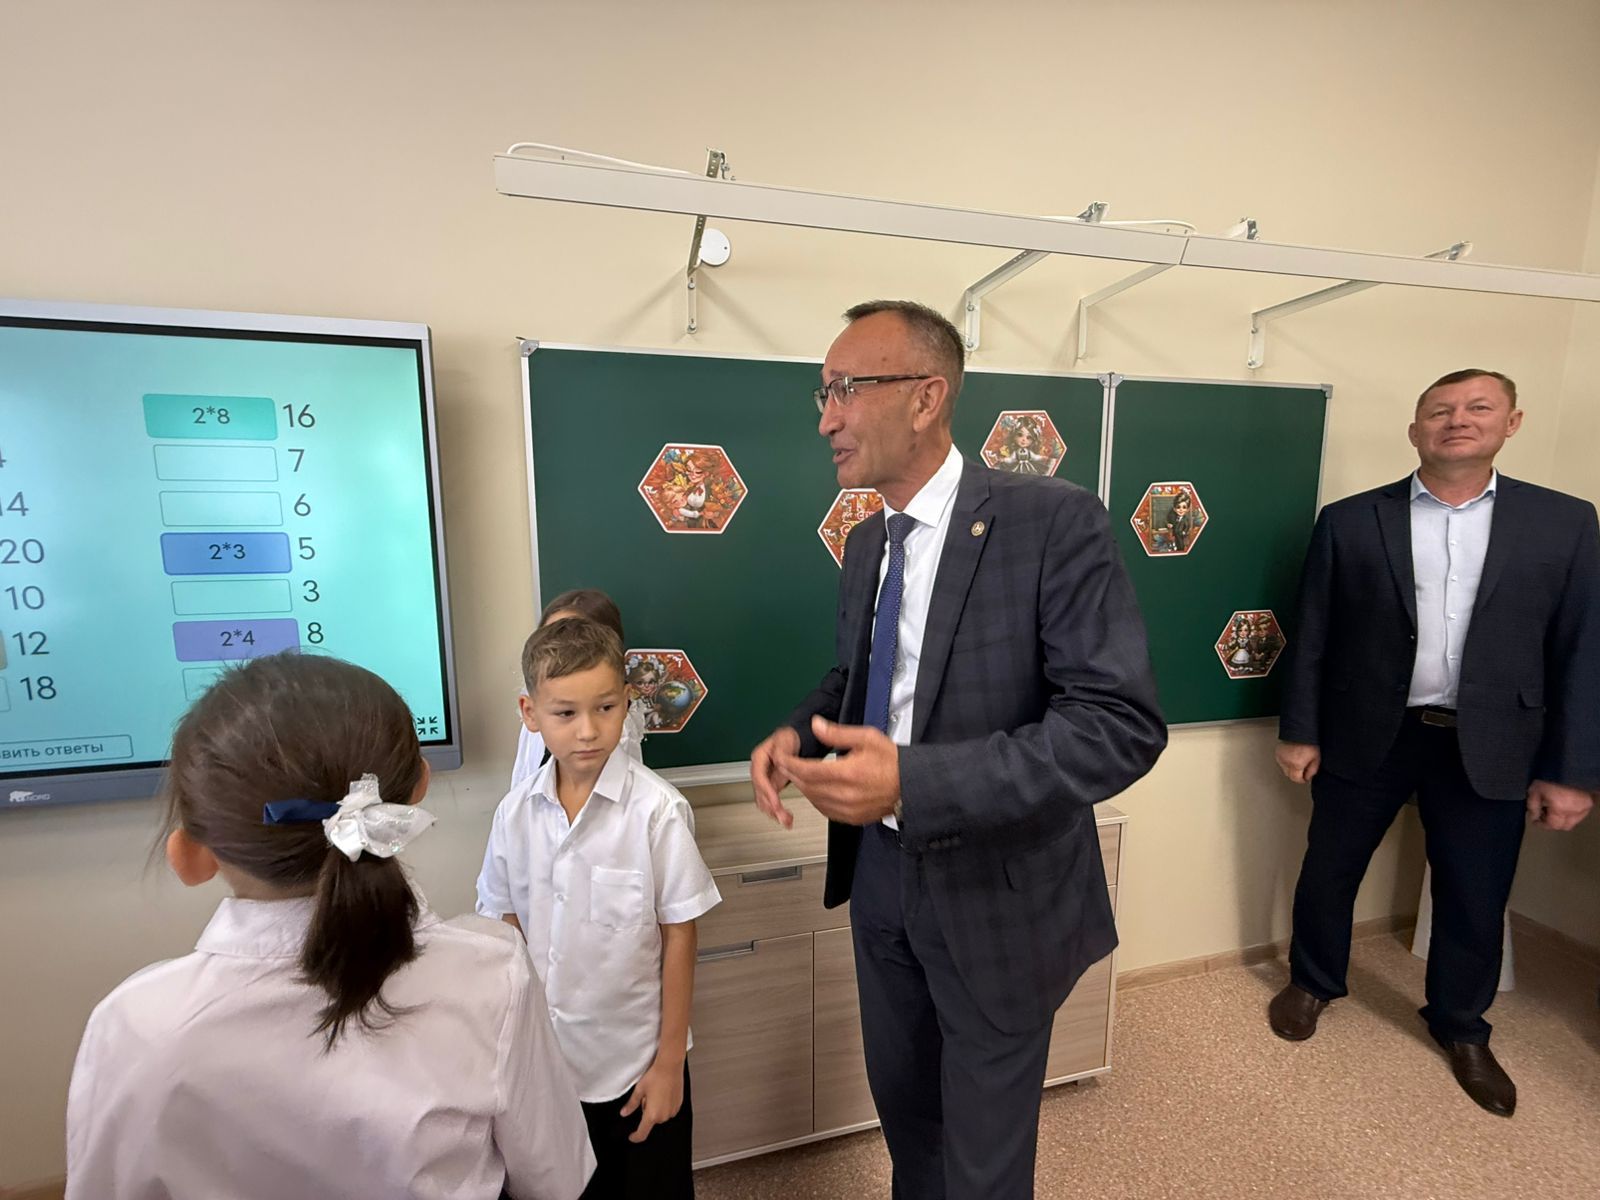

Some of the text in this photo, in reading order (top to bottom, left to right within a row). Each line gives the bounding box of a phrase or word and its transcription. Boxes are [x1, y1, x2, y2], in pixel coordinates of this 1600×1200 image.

[283, 403, 316, 428] 16
[288, 448, 305, 473] 7
[294, 493, 311, 517] 6
[0, 538, 45, 564] 20
[298, 537, 315, 560] 5
[5, 585, 45, 610] 10
[303, 580, 320, 603] 3
[12, 631, 50, 656] 12
[308, 622, 324, 644] 8
[20, 675, 57, 701] 18
[0, 743, 104, 759] вить ответы
